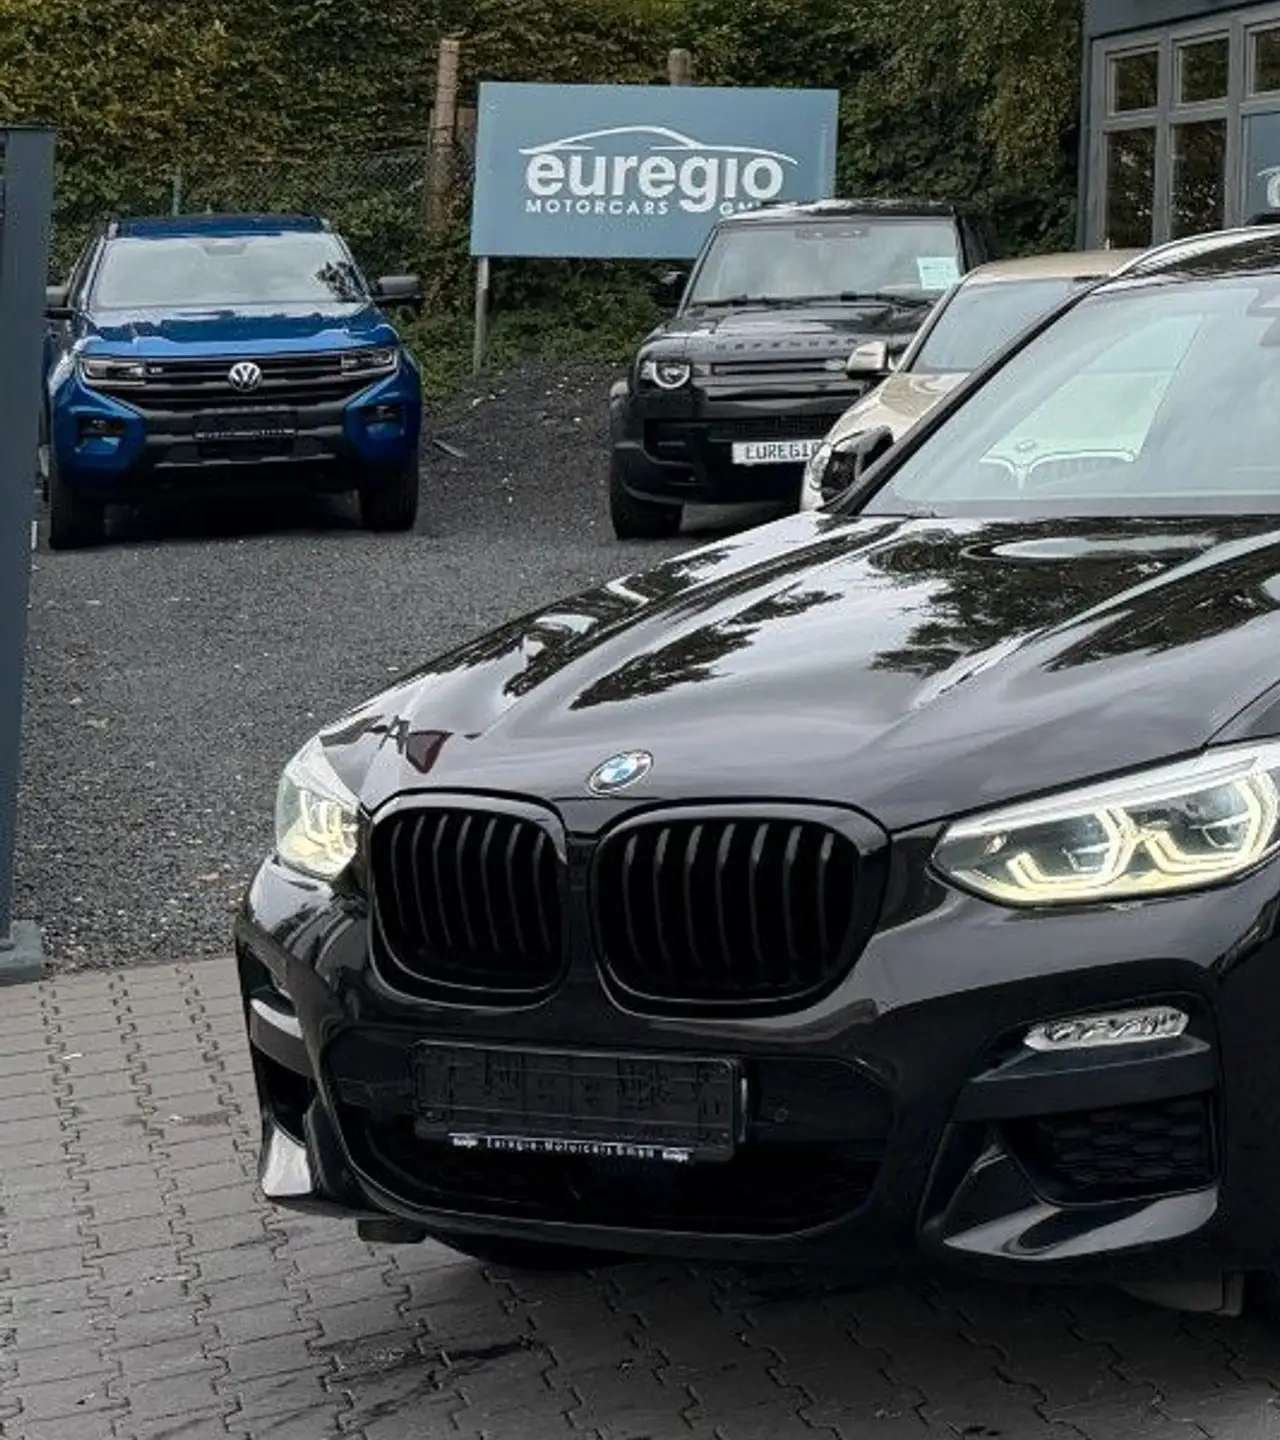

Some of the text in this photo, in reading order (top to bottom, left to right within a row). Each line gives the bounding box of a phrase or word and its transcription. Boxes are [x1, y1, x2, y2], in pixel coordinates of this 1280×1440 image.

[525, 154, 784, 213] euregio
[525, 199, 763, 216] MOTORCARS GM
